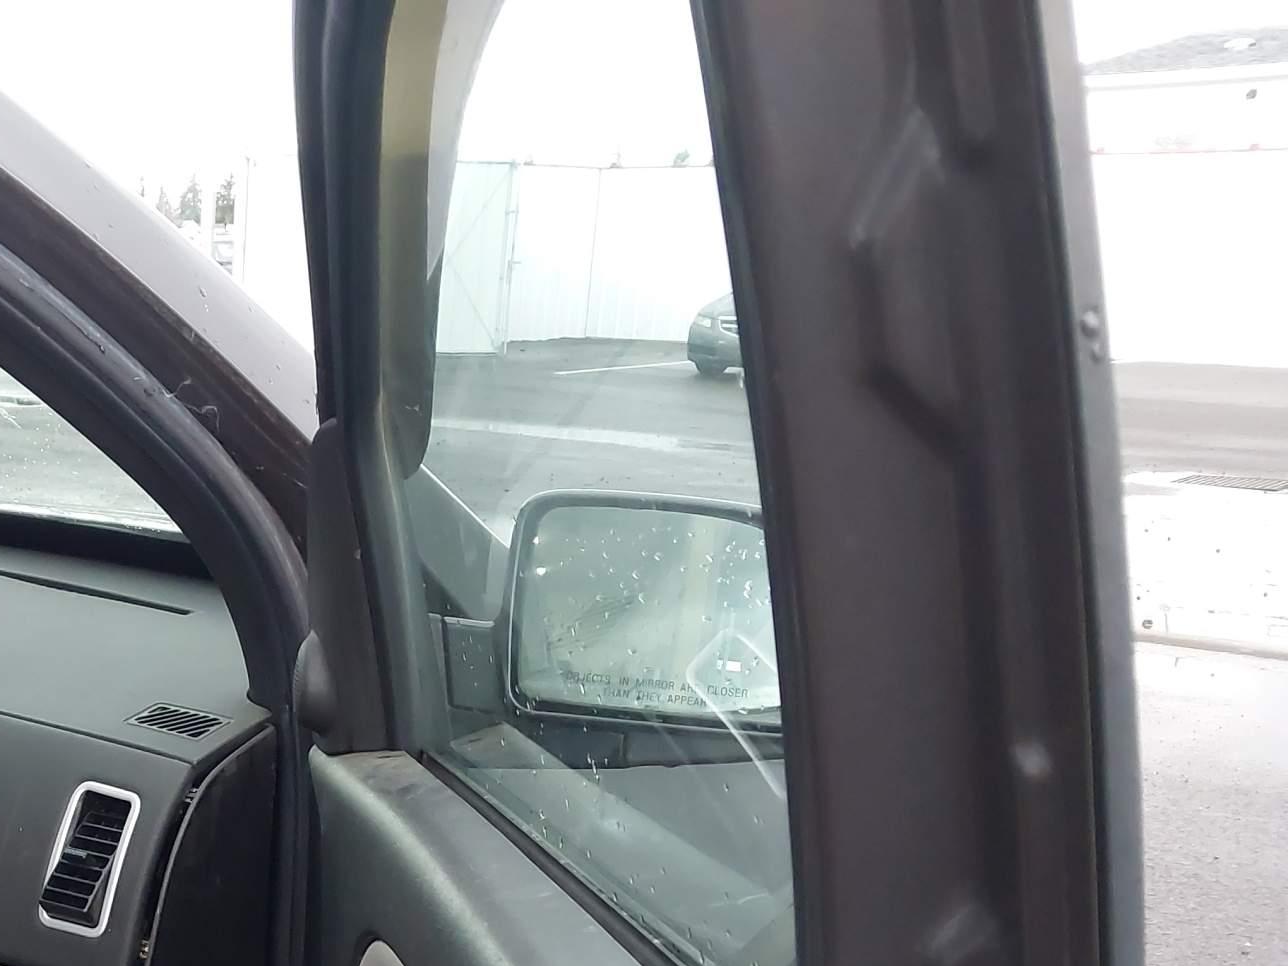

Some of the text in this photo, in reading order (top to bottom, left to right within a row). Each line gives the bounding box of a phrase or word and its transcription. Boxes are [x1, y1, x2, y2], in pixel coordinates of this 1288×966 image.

[566, 671, 611, 686] OBJECTS
[619, 677, 630, 687] IN
[635, 678, 675, 691] MIRROR
[707, 685, 749, 698] CLOSER
[603, 687, 630, 699] THAN
[636, 690, 662, 702] THEY
